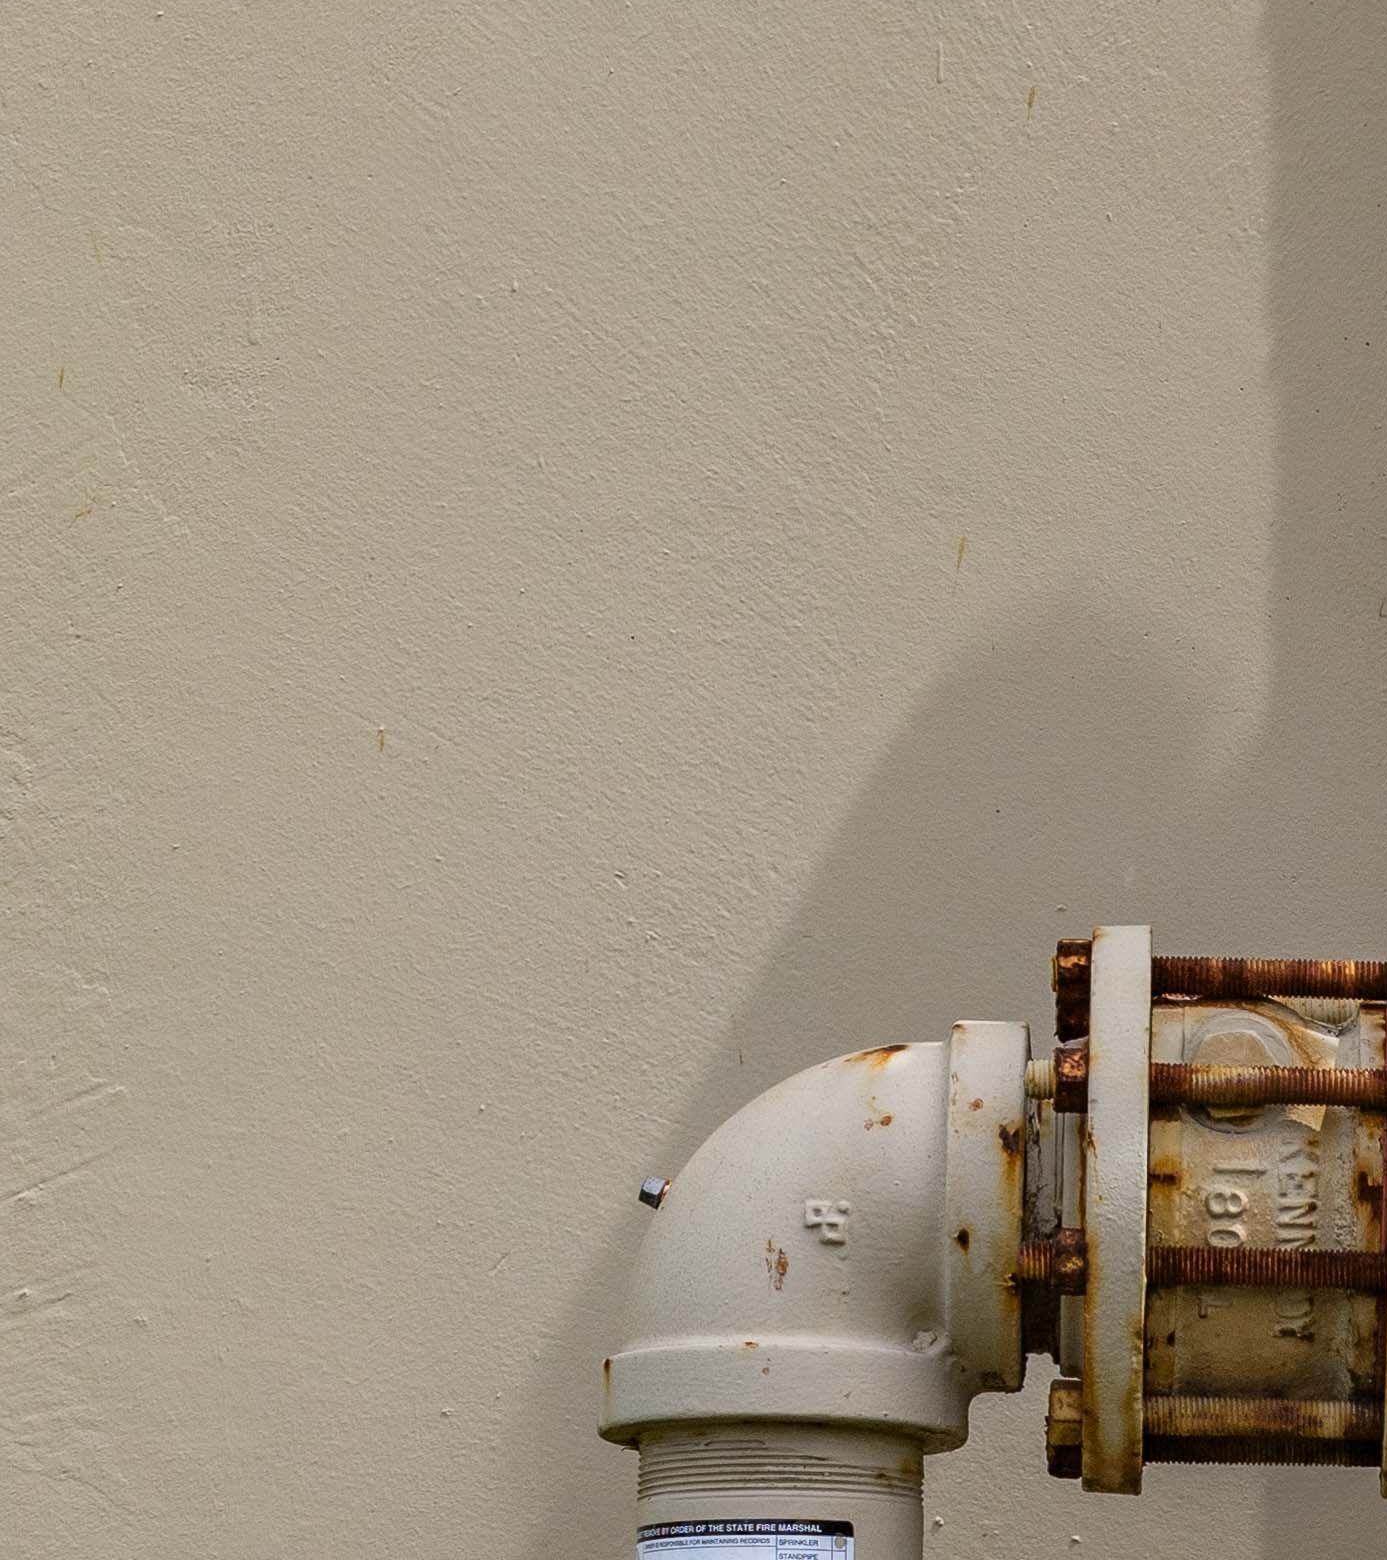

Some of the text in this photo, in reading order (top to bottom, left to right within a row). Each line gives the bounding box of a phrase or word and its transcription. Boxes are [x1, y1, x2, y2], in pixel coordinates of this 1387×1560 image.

[709, 1524, 725, 1532] THE
[727, 1524, 755, 1532] STATE
[756, 1524, 776, 1532] FIRE
[778, 1524, 822, 1533] MARSHAL
